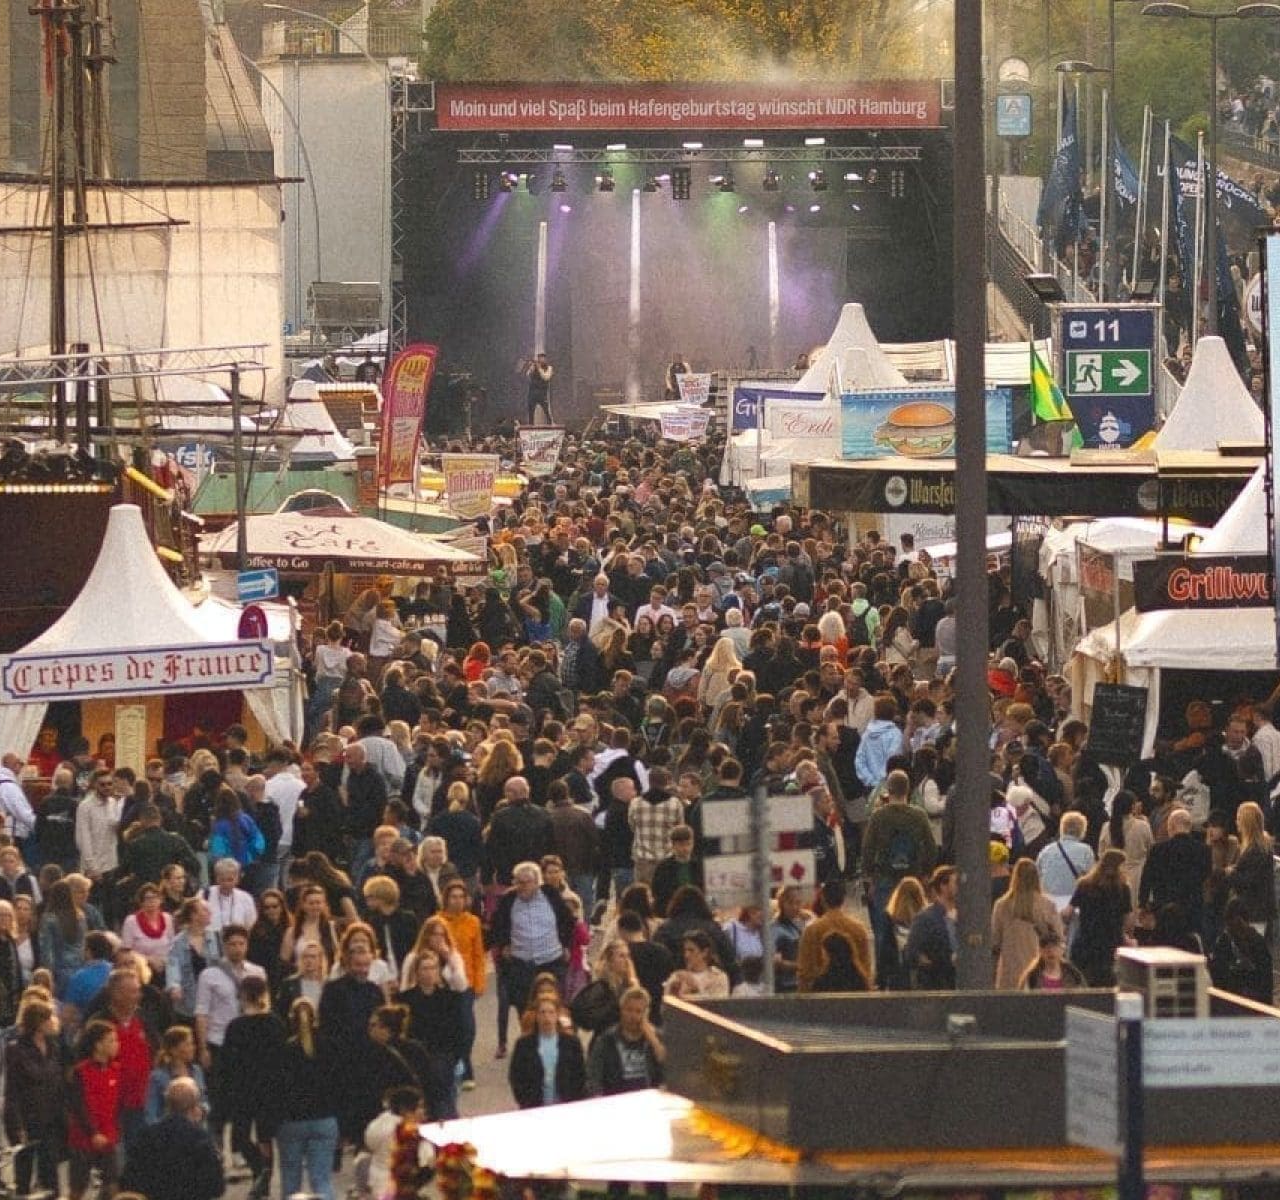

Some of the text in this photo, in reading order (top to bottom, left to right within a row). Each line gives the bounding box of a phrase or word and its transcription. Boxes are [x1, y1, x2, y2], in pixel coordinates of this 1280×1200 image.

[450, 97, 928, 121] Moin und viel Spaß beim Hafengeburtstag wünscht NDR Hamburg
[1094, 320, 1119, 341] 11
[910, 476, 956, 507] Warstei
[276, 557, 289, 569] to
[291, 556, 310, 569] Go
[1168, 566, 1270, 601] Grillwu
[12, 650, 263, 694] Crêpes de France
